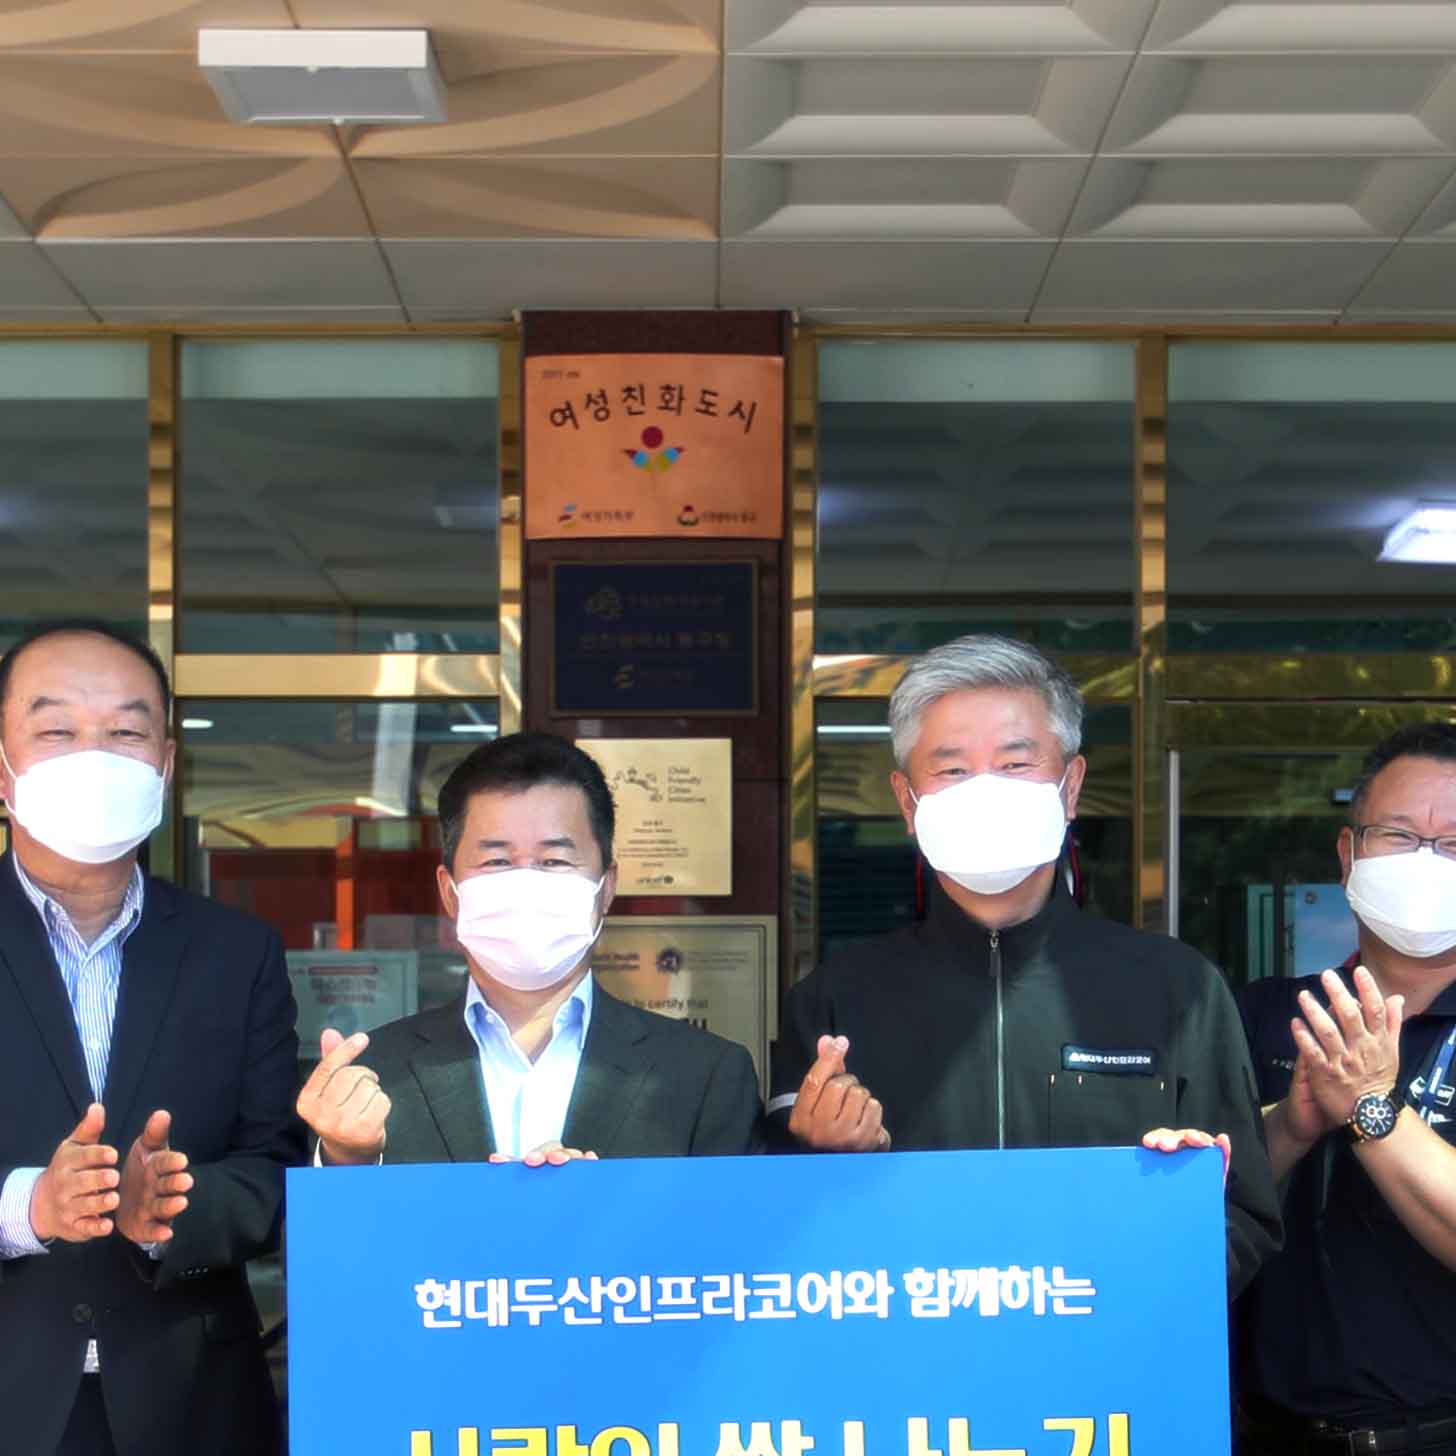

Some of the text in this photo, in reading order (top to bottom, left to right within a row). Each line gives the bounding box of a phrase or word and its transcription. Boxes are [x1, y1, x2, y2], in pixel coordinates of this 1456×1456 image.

[550, 383, 757, 434] 여성친화도시
[647, 999, 684, 1010] certify
[414, 1264, 1096, 1329] 현대두산인프라코어와 함께하는
